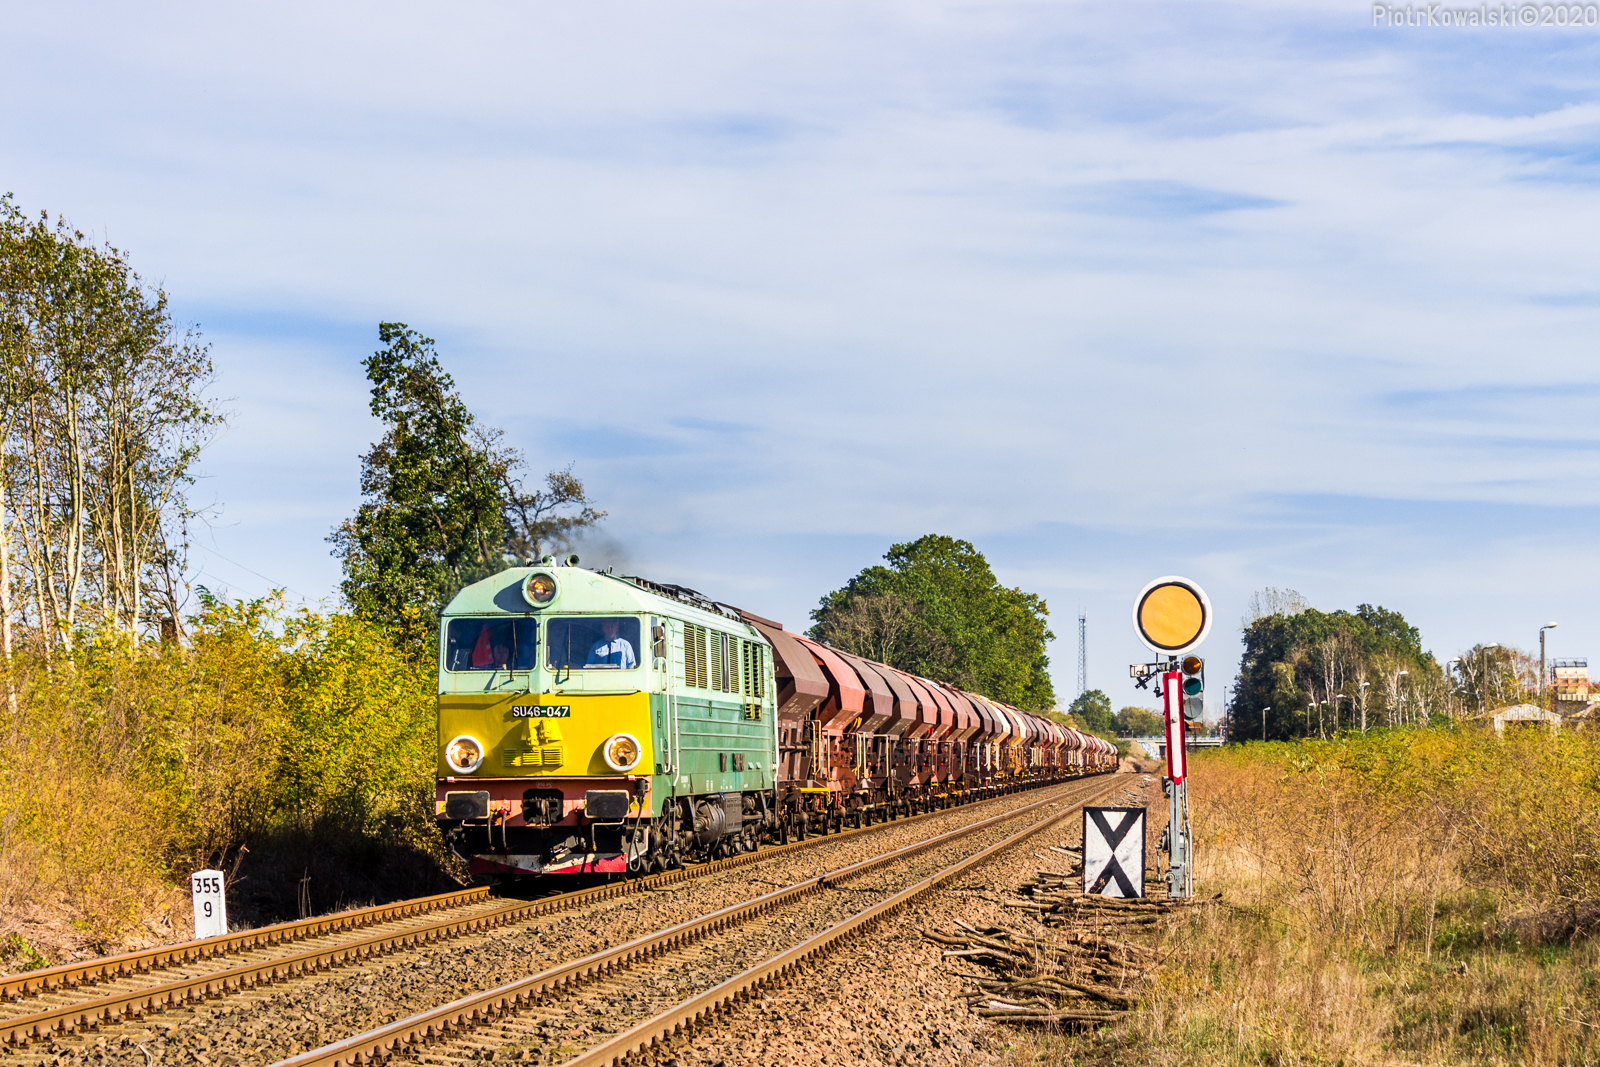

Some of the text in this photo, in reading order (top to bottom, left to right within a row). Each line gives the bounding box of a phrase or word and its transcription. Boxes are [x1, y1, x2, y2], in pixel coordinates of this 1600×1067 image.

[513, 706, 569, 717] SU46-047
[194, 877, 220, 893] 355
[204, 901, 212, 918] 9
